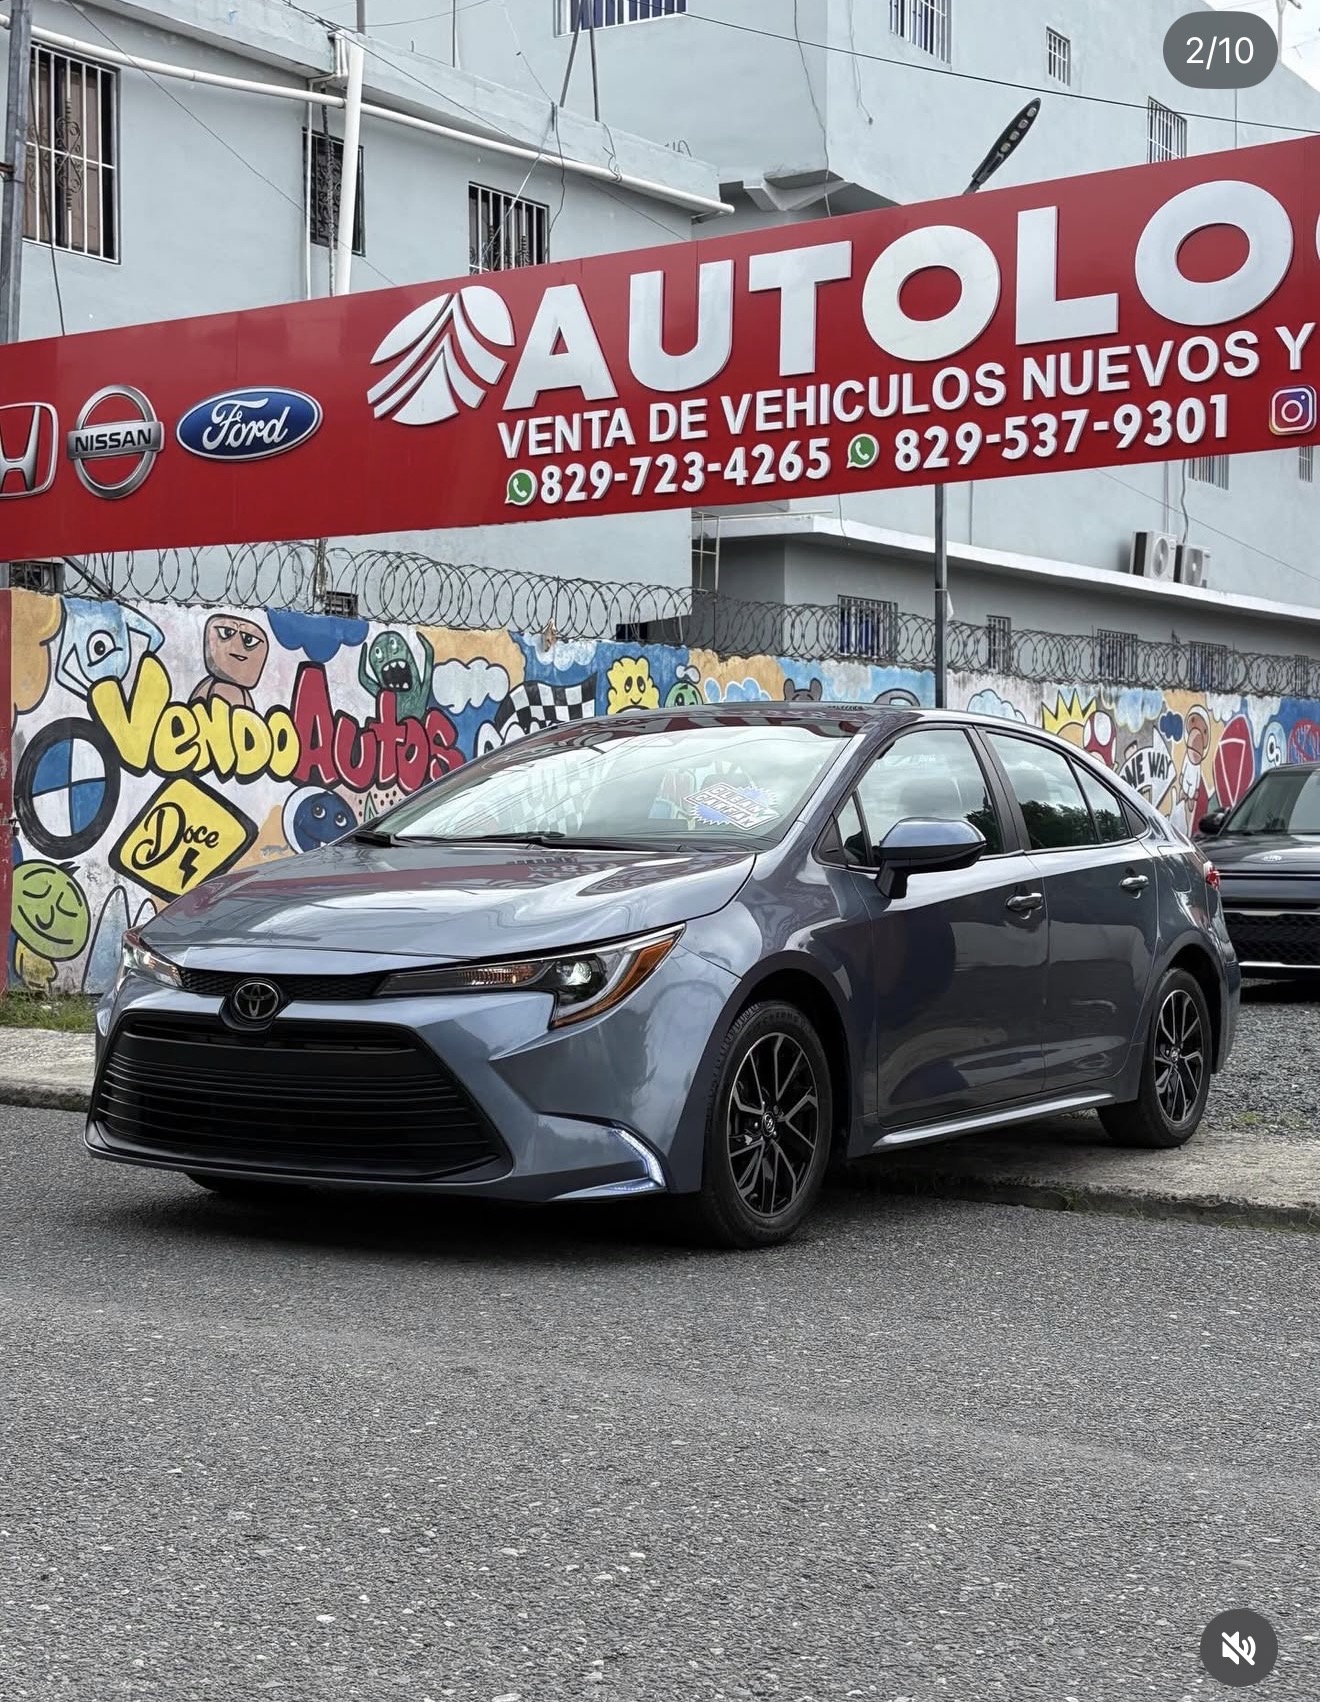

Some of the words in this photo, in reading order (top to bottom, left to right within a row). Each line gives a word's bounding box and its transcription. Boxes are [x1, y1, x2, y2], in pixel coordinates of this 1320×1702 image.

[503, 180, 1320, 410] AUTOLO
[202, 397, 291, 450] Ford
[497, 407, 636, 459] VENTA
[649, 398, 709, 443] DE
[720, 362, 1007, 435] VEHICULOS
[1022, 330, 1260, 401] NUEVOS
[1274, 322, 1317, 371] Y
[75, 428, 153, 453] NISSAN
[894, 393, 1229, 472] 829-537-9301
[540, 437, 832, 504] 829-723-4265
[1120, 752, 1145, 790] NE
[1148, 751, 1173, 781] WAY
[131, 801, 220, 871] Doce
[693, 792, 755, 826] CARFAX
